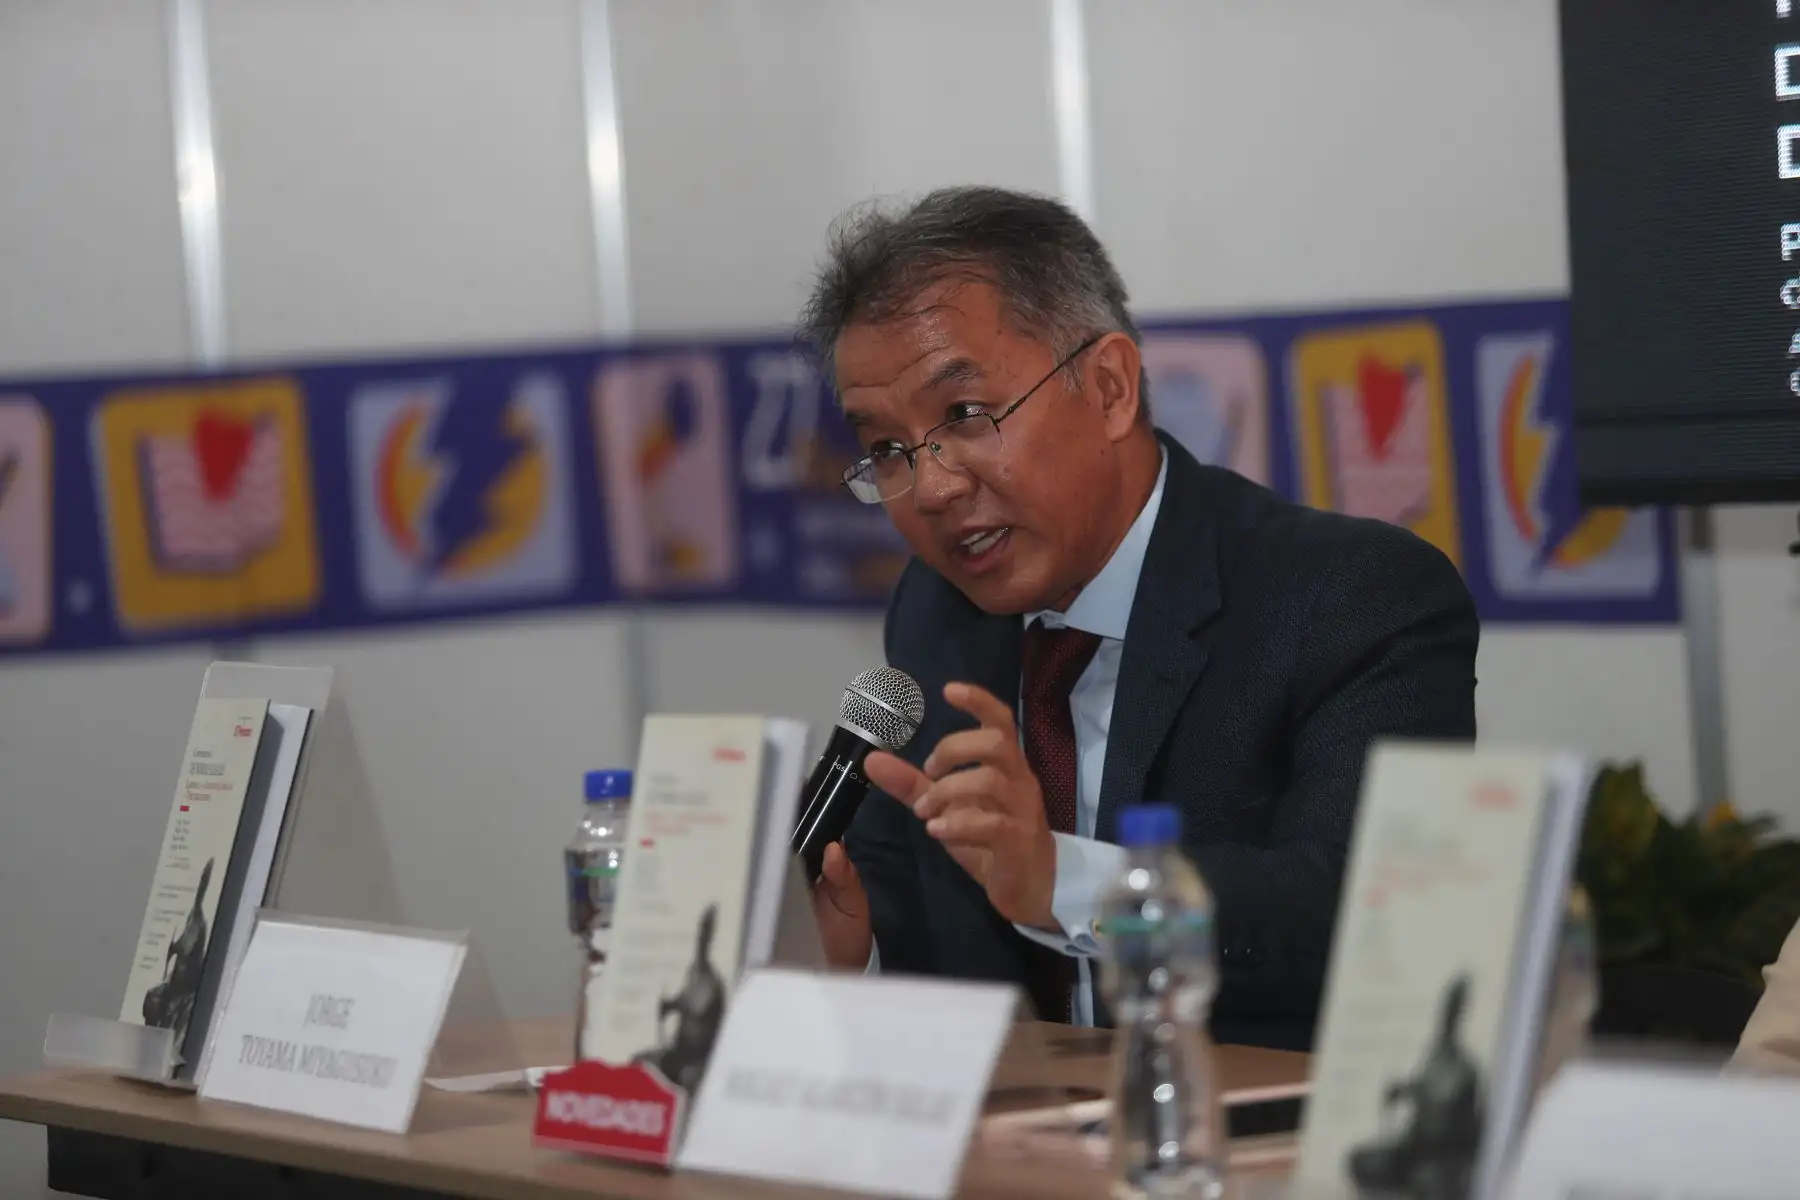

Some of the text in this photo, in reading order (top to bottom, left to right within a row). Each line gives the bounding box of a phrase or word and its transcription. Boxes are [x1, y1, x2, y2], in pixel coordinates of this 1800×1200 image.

[301, 993, 356, 1030] JORGE
[239, 1033, 298, 1074] TOYAMA
[546, 1089, 667, 1136] NOVEDADES
